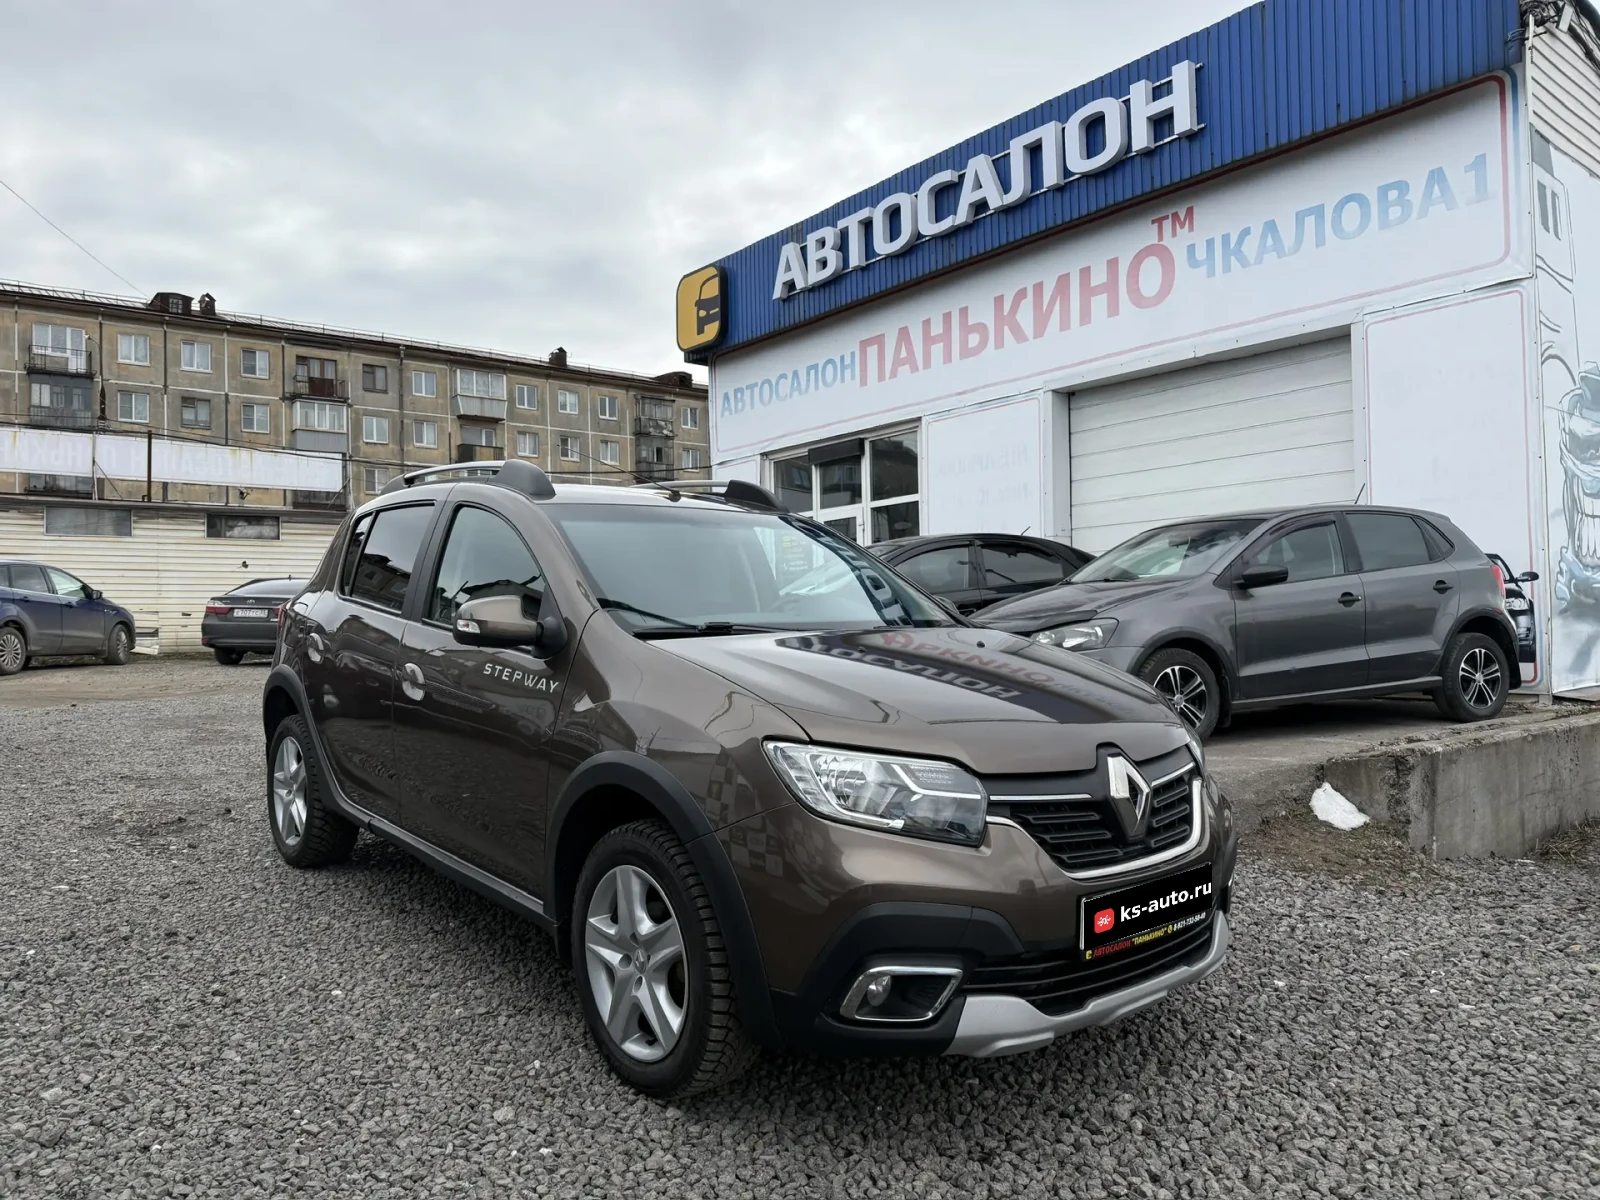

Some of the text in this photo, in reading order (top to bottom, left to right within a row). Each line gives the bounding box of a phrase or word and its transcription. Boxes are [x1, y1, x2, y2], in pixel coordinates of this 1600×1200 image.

[772, 60, 1198, 300] АВТОСАЛОН
[720, 351, 856, 418] АВТОСАЛОН
[859, 243, 1175, 387] ПАНЬКИНО
[1151, 205, 1195, 242] ТМ
[483, 663, 559, 693] STEPWAY
[1093, 940, 1131, 957] АВТОСАЛОН
